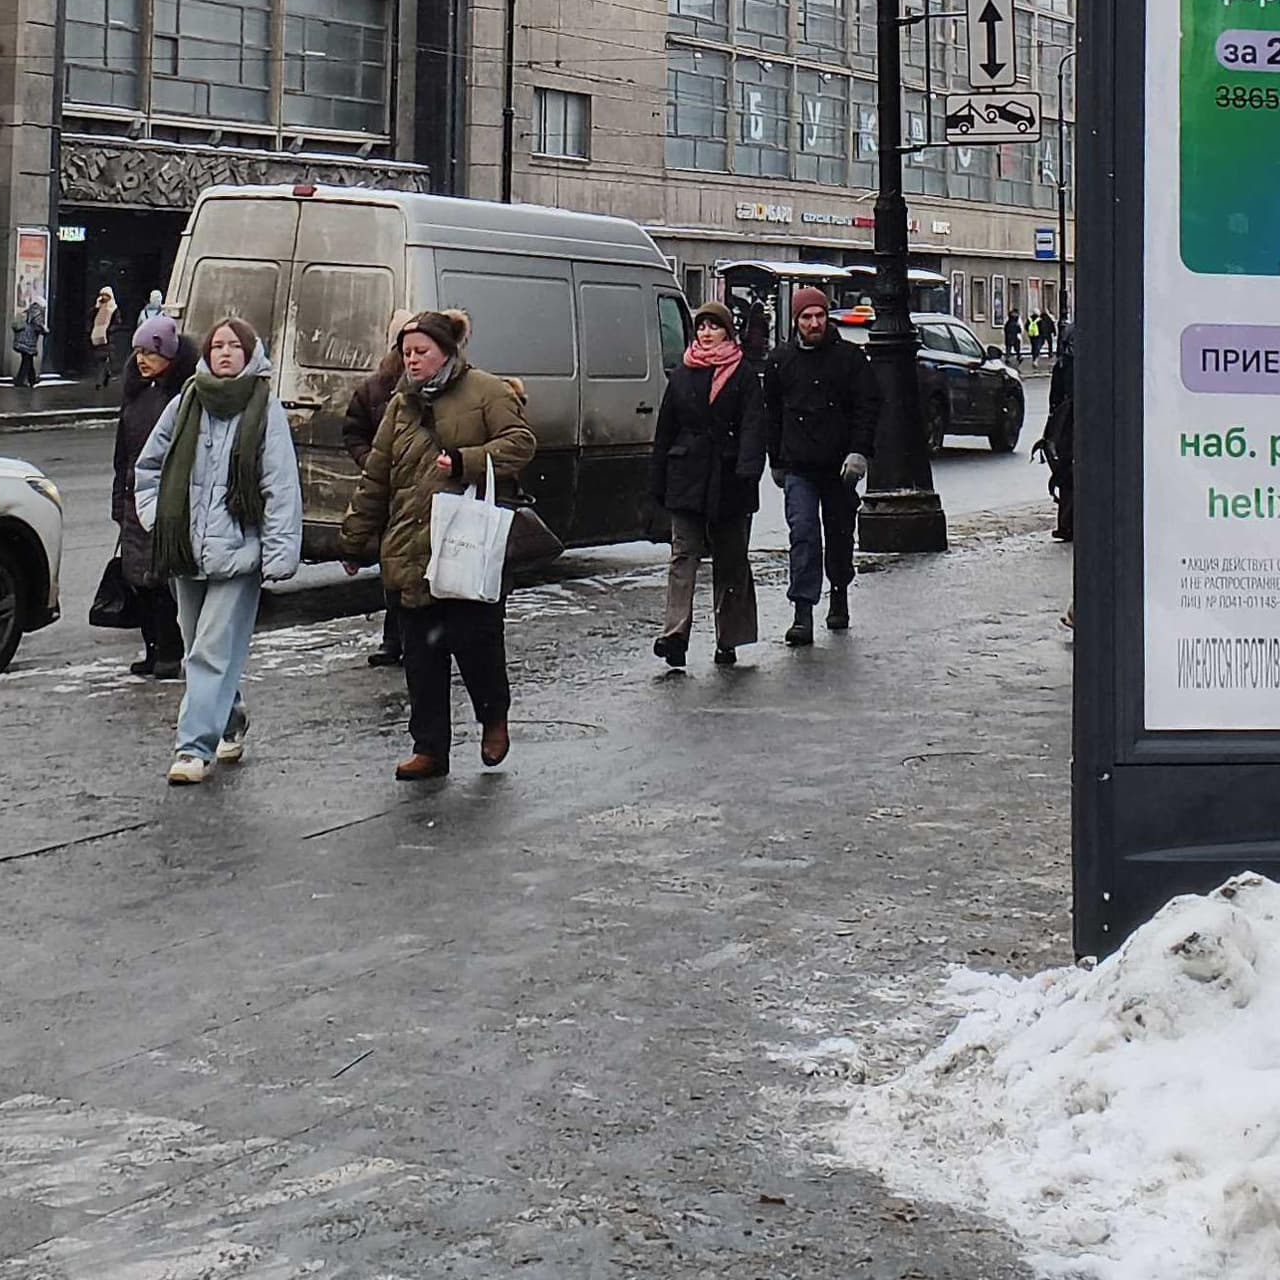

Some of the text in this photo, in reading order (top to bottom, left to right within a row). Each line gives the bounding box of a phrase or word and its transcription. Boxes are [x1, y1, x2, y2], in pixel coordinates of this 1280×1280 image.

[1223, 43, 1258, 65] за
[1215, 85, 1279, 110] 3865
[1180, 427, 1256, 458] наб.
[1177, 638, 1232, 689] ИМЕЮТСЯ
